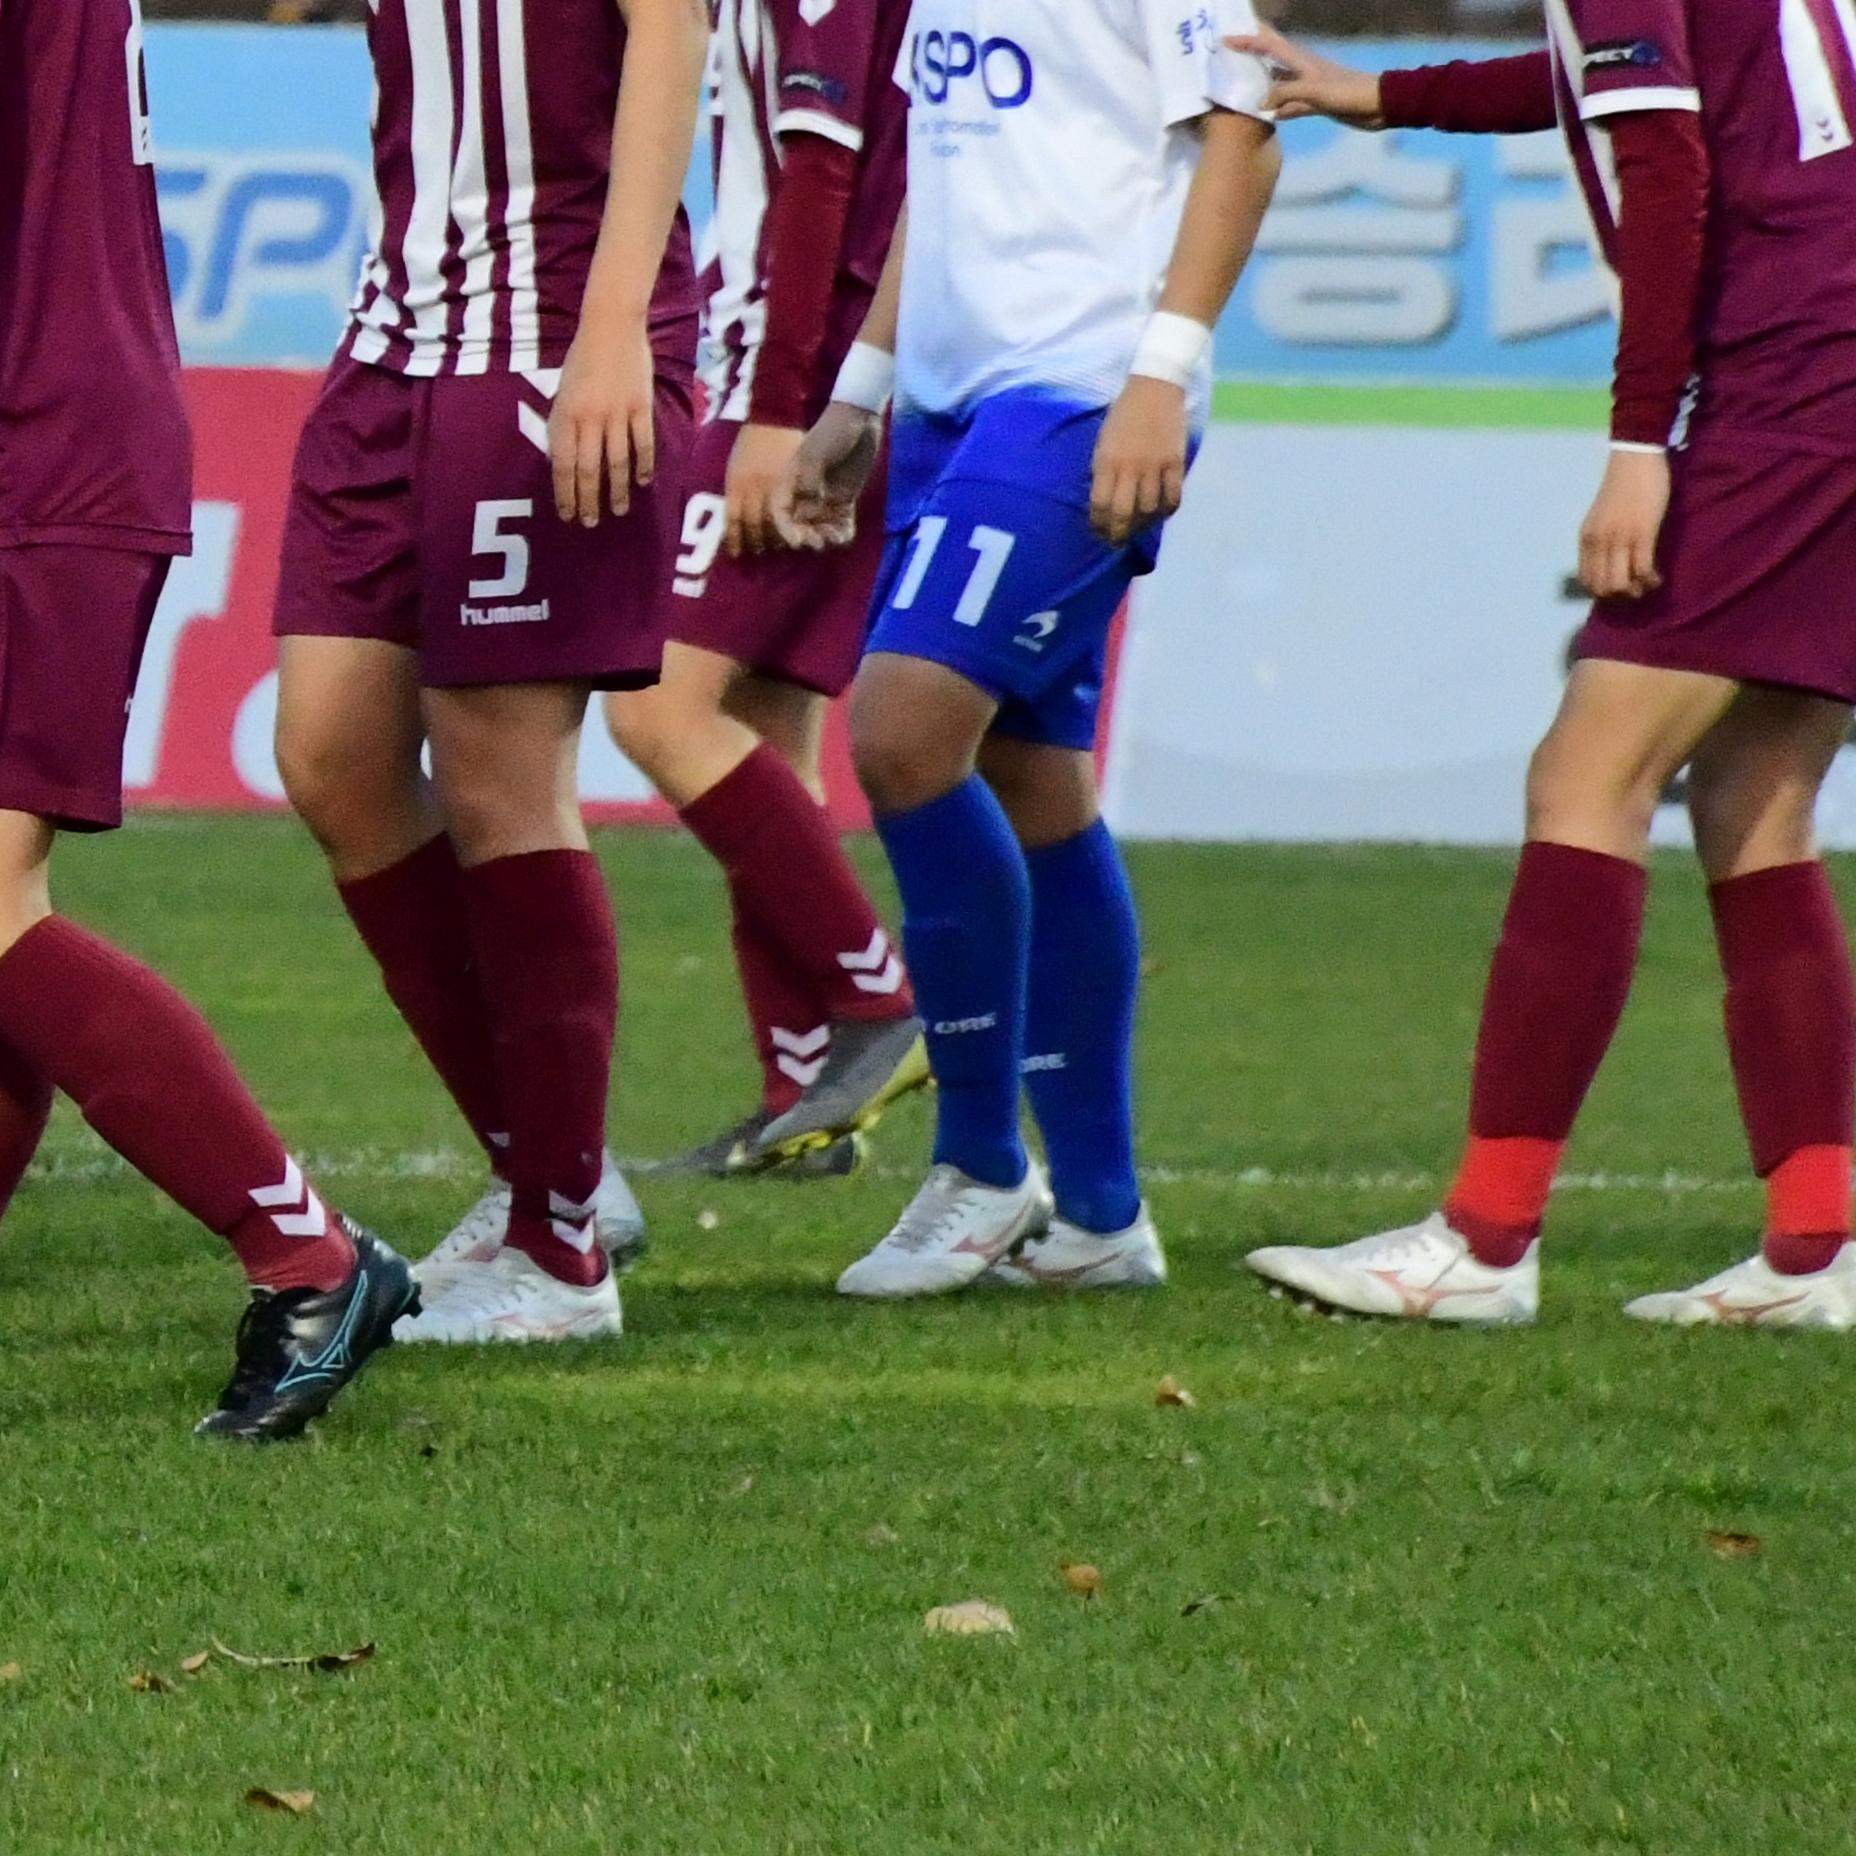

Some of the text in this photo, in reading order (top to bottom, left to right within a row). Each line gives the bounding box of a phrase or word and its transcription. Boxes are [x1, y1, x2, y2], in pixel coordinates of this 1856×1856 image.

[469, 500, 533, 598] 5
[675, 491, 726, 575] 9
[893, 517, 1015, 627] 11
[460, 600, 550, 627] hummel
